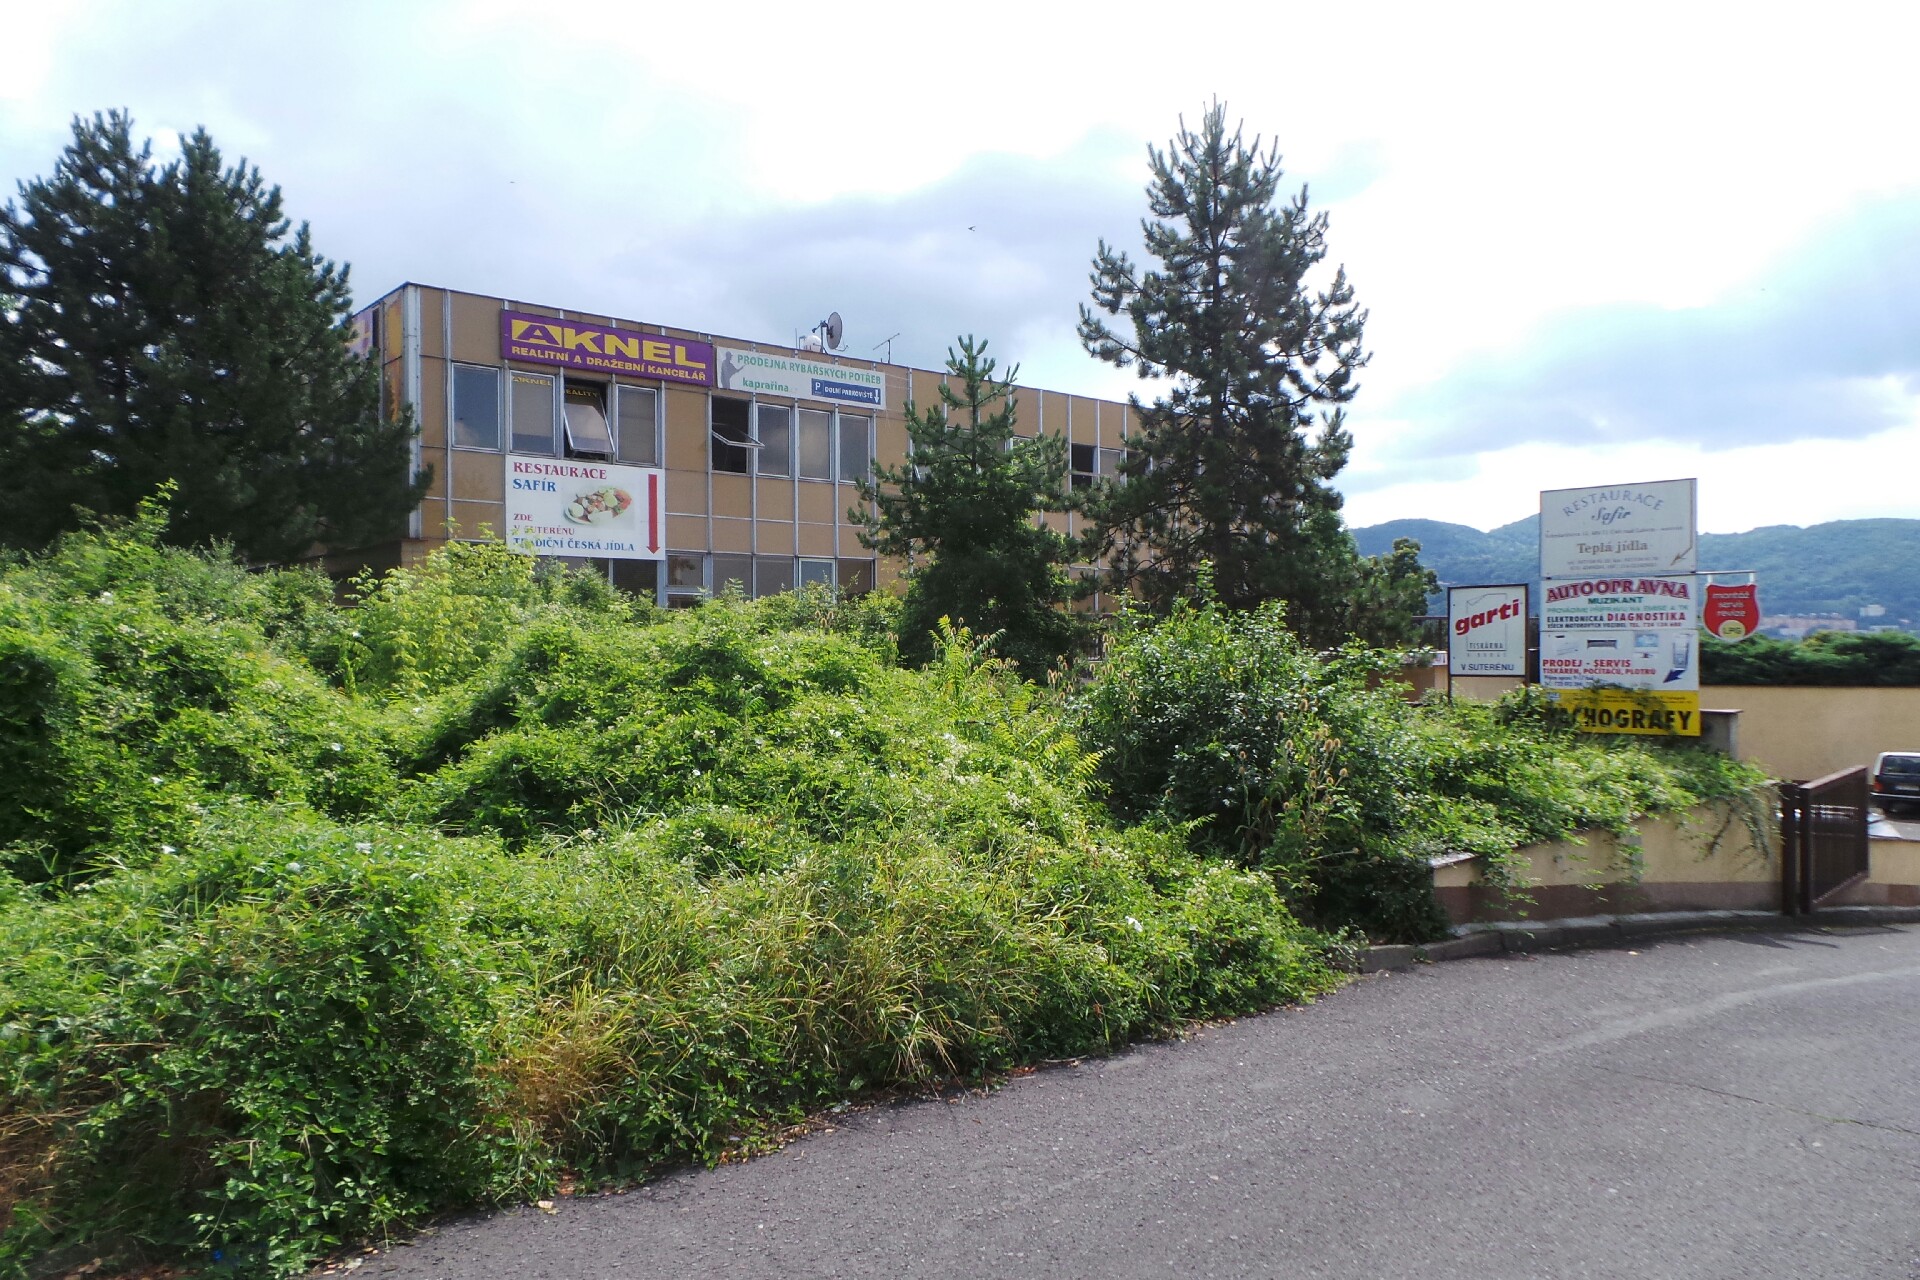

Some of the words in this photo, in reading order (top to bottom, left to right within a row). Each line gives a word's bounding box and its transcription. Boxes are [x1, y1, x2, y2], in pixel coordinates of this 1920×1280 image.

[511, 319, 706, 369] AKNEL
[511, 345, 569, 361] REALITNÍ
[574, 355, 582, 364] A
[586, 356, 645, 372] DRAŽEBNÍ
[647, 364, 706, 381] KANCELÁŘ
[737, 353, 787, 371] PRODEJNA
[849, 371, 881, 385] POTŘEB
[564, 388, 598, 398] EALITY
[824, 385, 841, 395] DOLNÍ
[513, 461, 607, 480] RESTAURACE
[513, 477, 557, 492] SAFÍR
[1562, 489, 1664, 517] RESTAURACE
[513, 513, 533, 522] ZDE
[567, 537, 601, 551] ČESKÁ
[604, 540, 635, 552] JÍDLA
[1577, 540, 1613, 556] Teplá
[1617, 540, 1648, 554] jídla
[1545, 579, 1691, 604] AUTOOPRAVNA
[1587, 597, 1644, 605] MUZIKANT
[1455, 599, 1519, 636] garti
[1607, 612, 1686, 621] DIAGNOSTIKA
[1461, 663, 1467, 671] V
[1468, 662, 1514, 671] SUTERÉNU
[1542, 659, 1582, 668] PRODEJ
[1594, 659, 1631, 668] SERVIS
